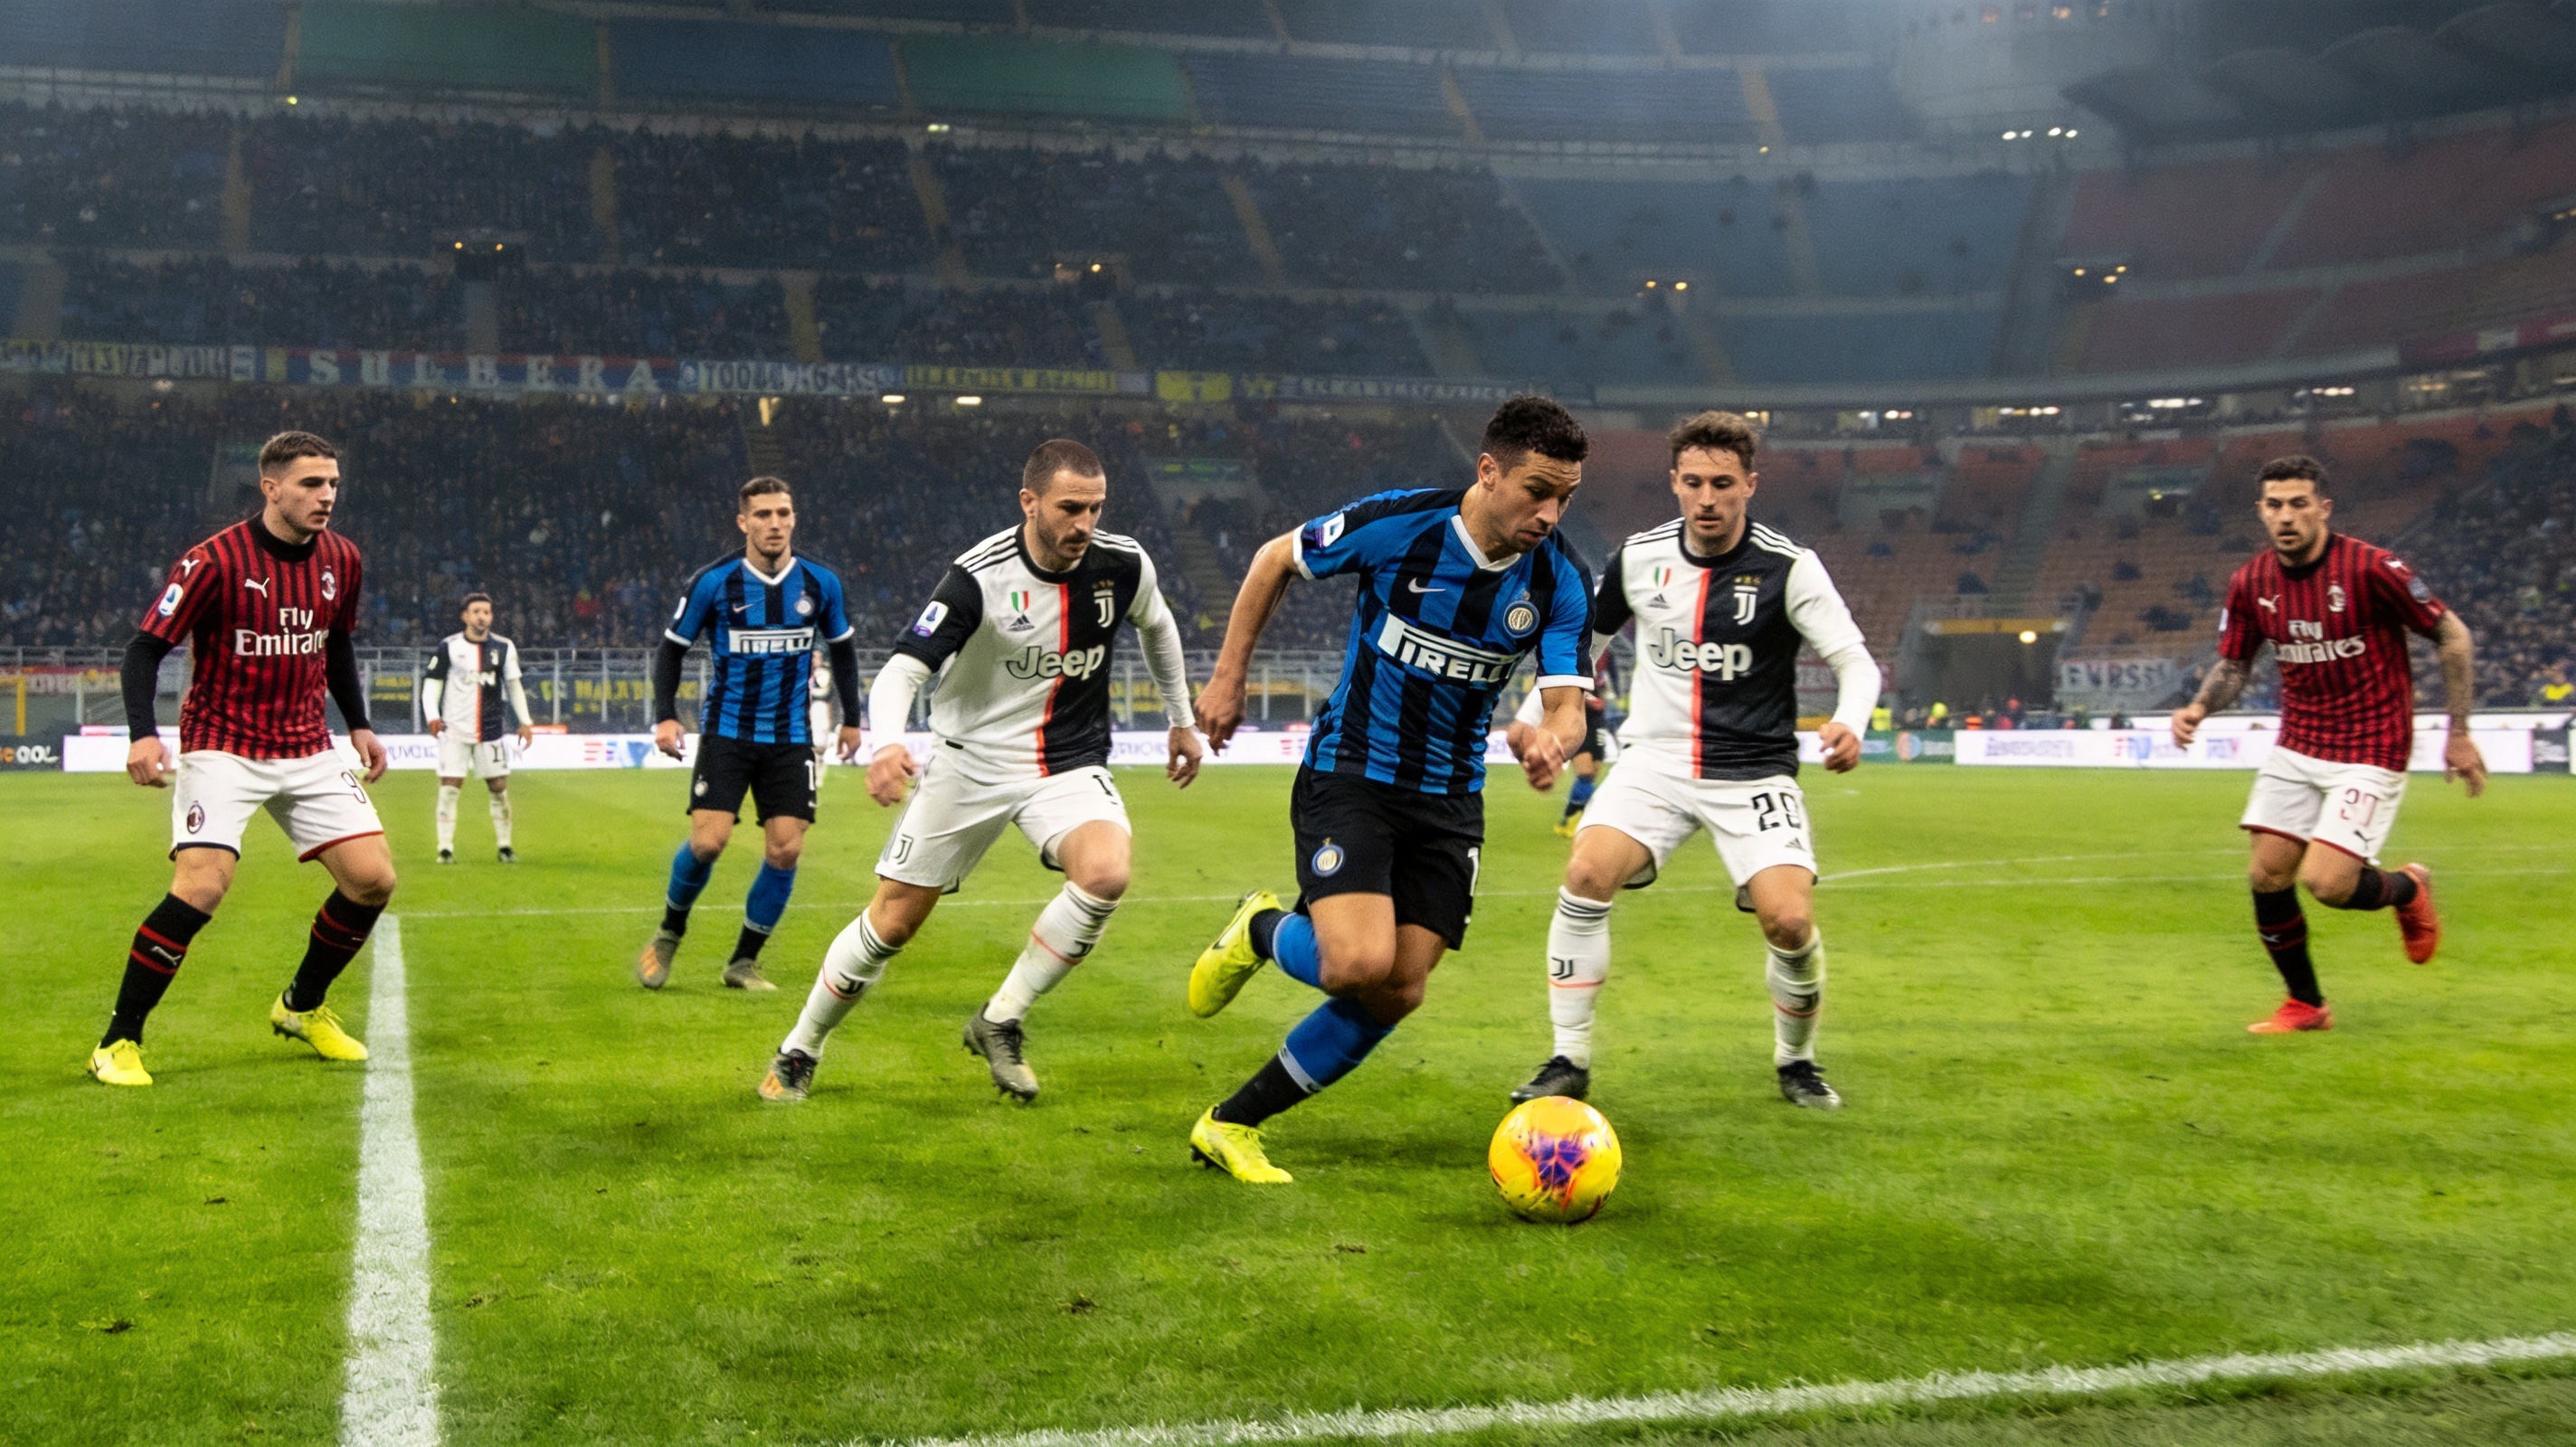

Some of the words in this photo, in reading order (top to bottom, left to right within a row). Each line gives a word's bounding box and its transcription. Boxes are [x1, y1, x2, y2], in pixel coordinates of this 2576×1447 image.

[279, 607, 314, 630] Fly
[1006, 645, 1106, 680] Jeep
[1646, 627, 1753, 681] Jeep
